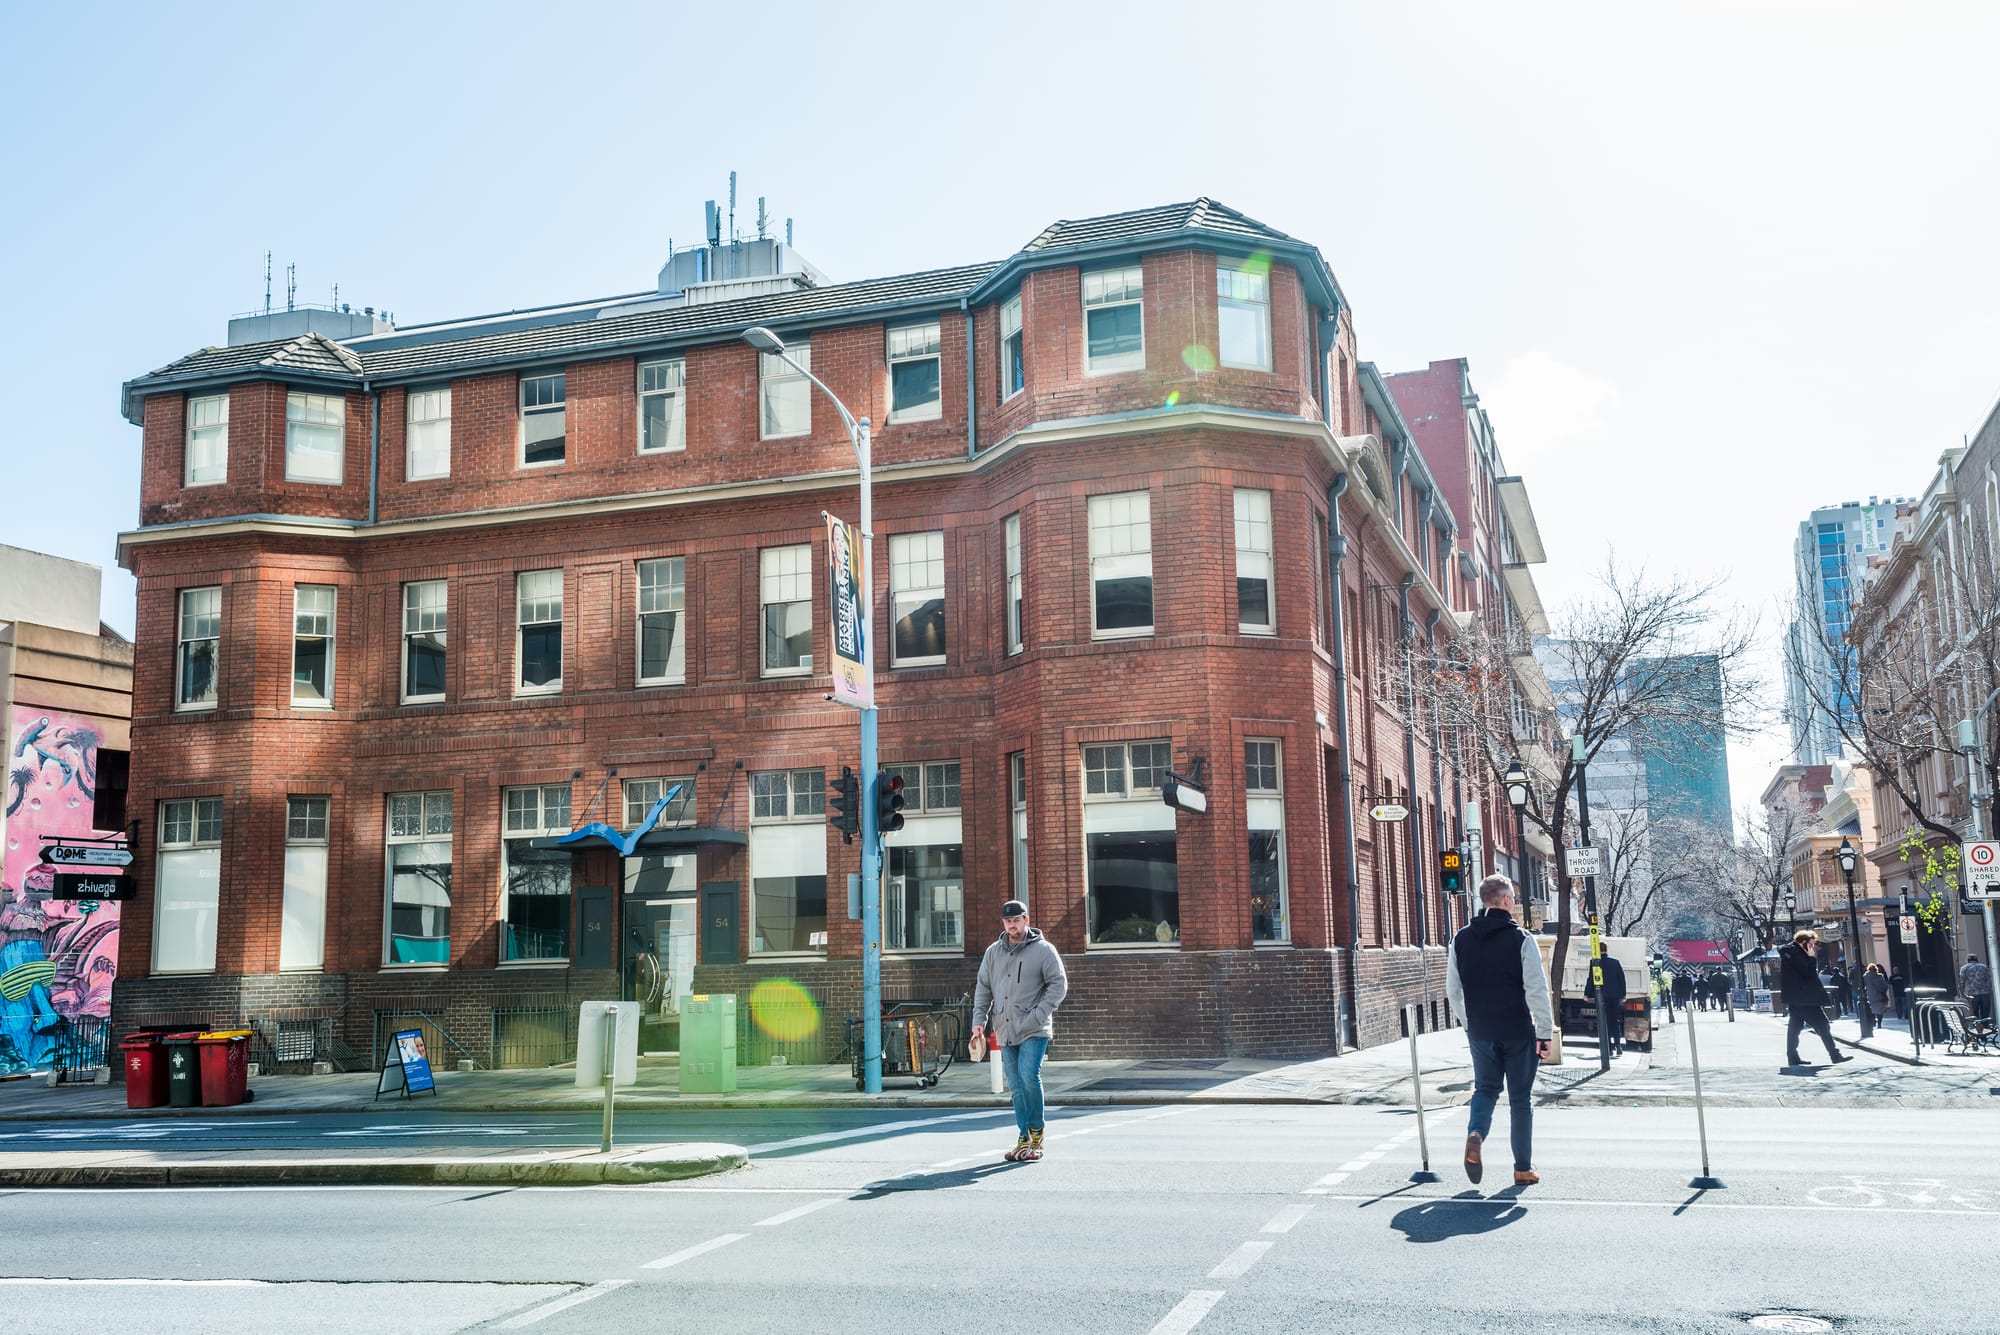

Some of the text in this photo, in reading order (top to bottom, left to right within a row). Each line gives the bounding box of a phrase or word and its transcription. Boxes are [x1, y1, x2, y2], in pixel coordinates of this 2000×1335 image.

[56, 847, 87, 859] DOME
[1578, 849, 1590, 857] NO
[1976, 850, 1988, 860] 10
[1444, 855, 1459, 867] 20
[1569, 857, 1599, 866] THROUGH
[1574, 866, 1595, 874] ROAD
[77, 879, 116, 898] zhivago
[587, 922, 601, 932] 54
[715, 917, 729, 928] 54
